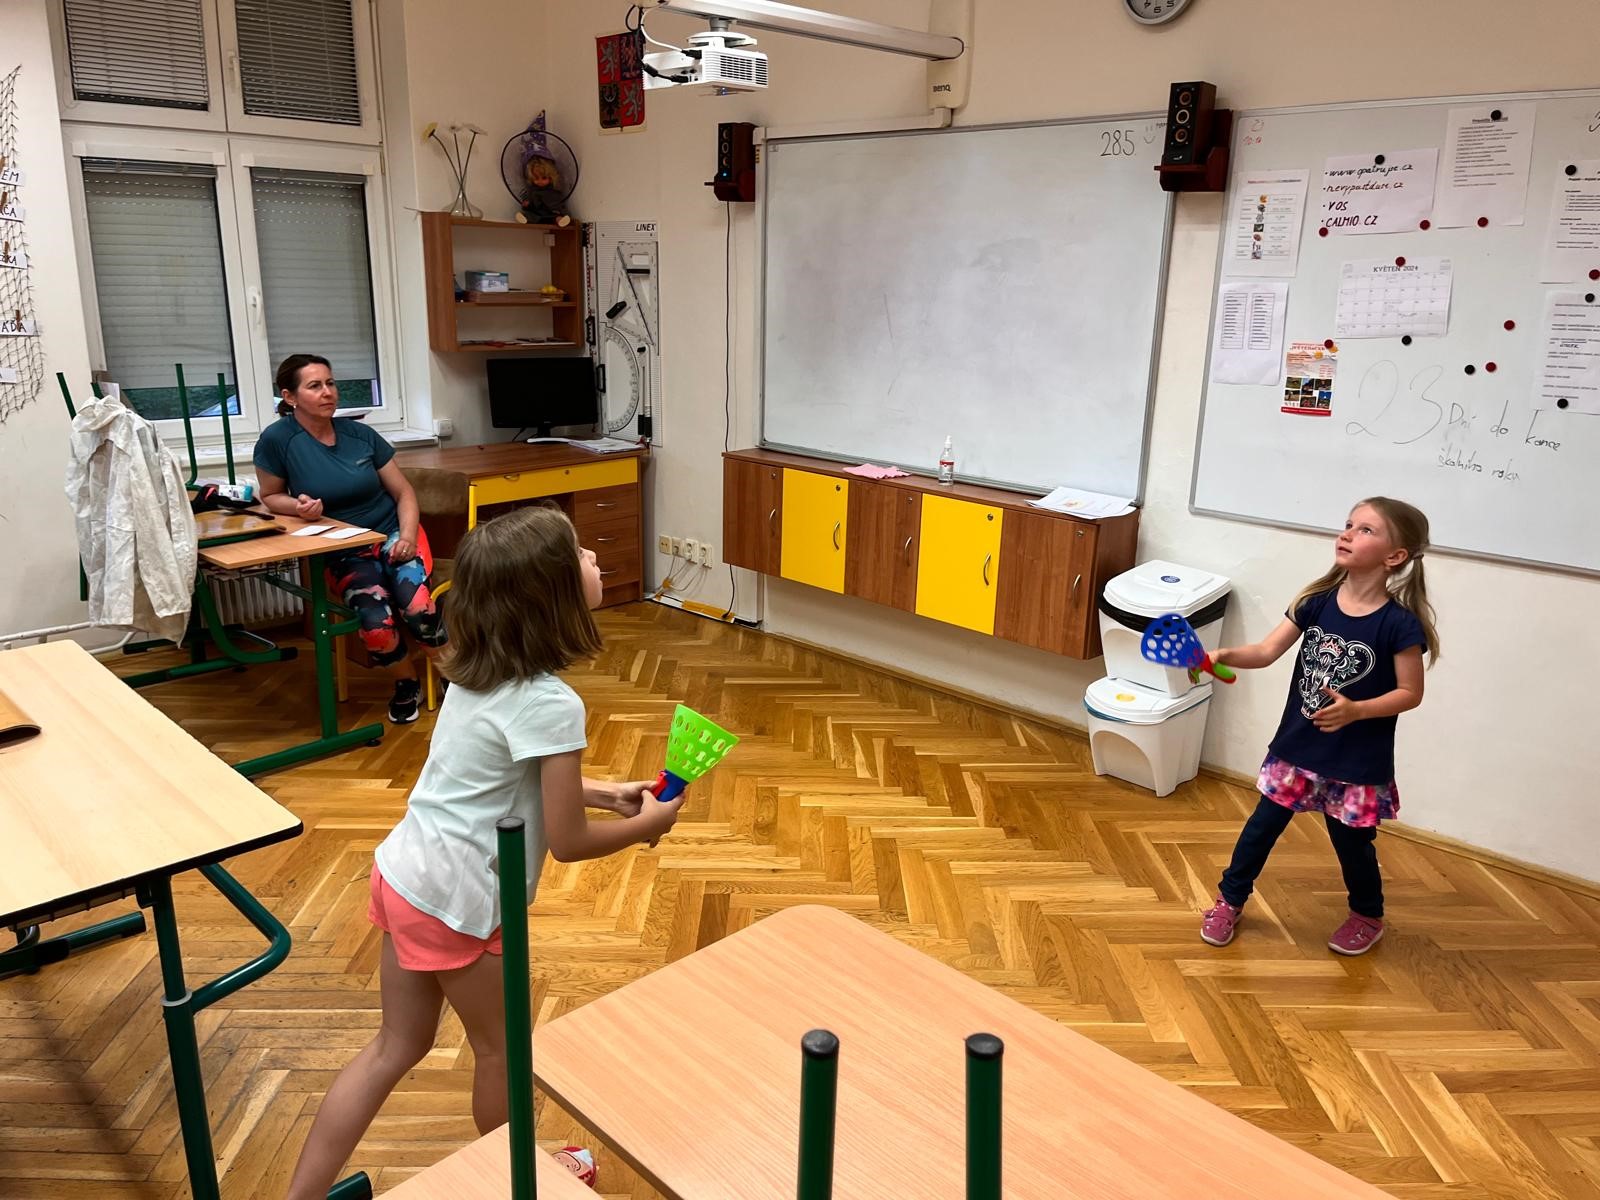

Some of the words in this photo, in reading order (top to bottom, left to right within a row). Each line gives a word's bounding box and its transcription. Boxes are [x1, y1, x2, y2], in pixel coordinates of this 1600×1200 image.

[1154, 6, 1162, 14] 6
[635, 223, 656, 232] LINEX
[1373, 265, 1401, 273] KVĚTEN
[1346, 360, 1443, 445] 23
[1489, 398, 1509, 438] do
